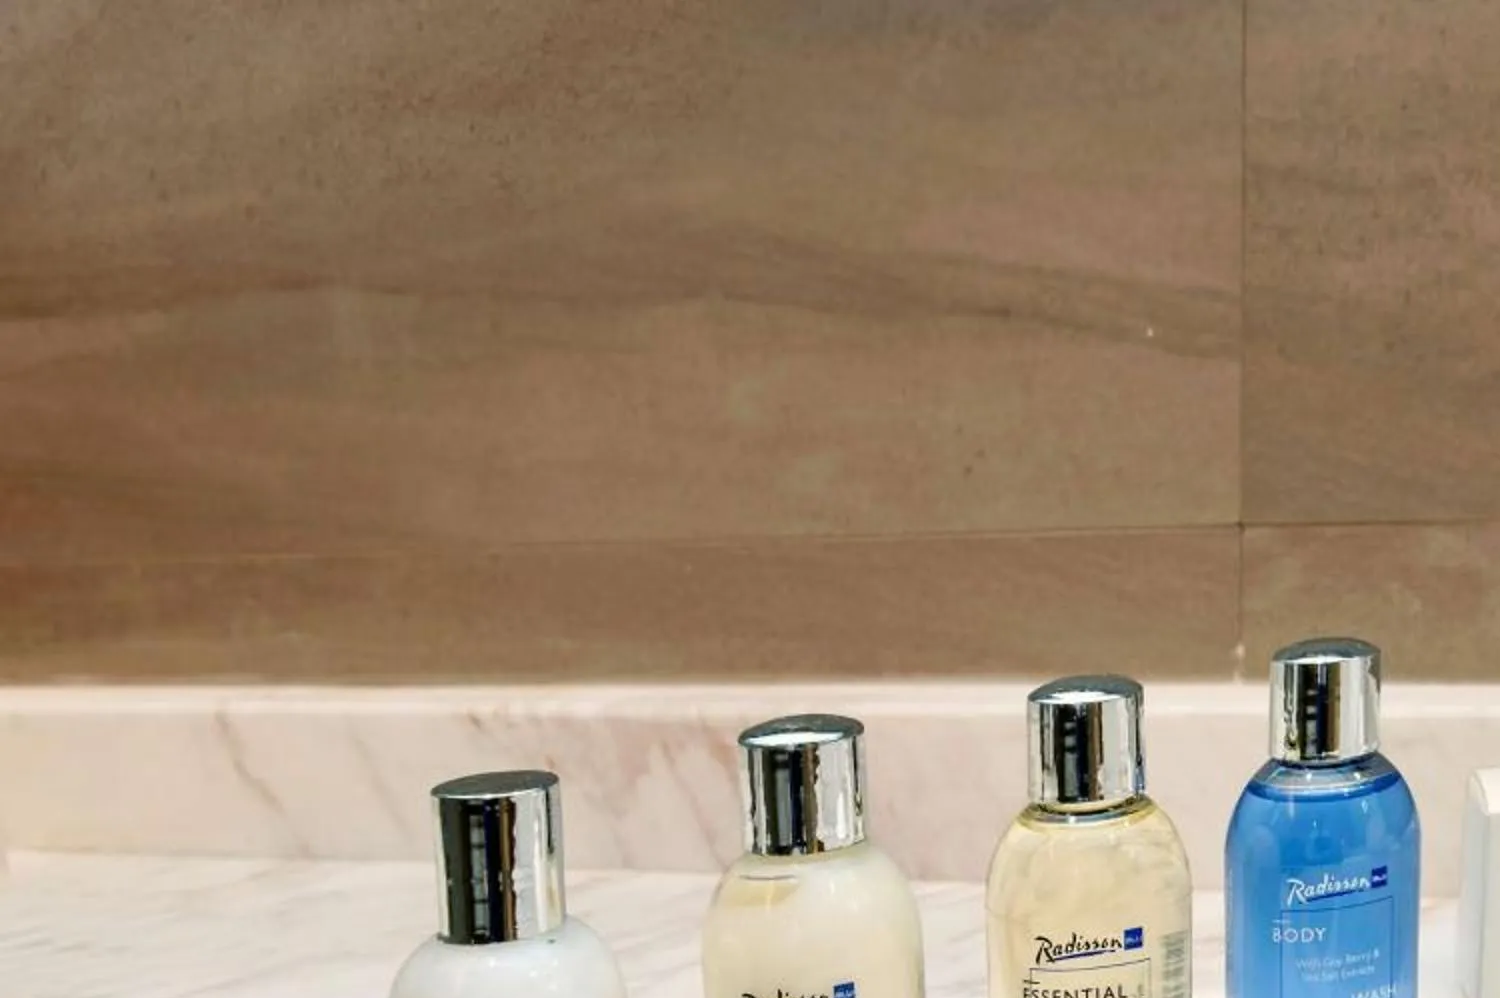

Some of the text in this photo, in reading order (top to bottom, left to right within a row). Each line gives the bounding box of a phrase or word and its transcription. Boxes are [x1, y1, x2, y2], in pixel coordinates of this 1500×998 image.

[1286, 873, 1371, 907] Radisson
[1034, 932, 1122, 964] Radisson
[1272, 927, 1326, 943] BODY
